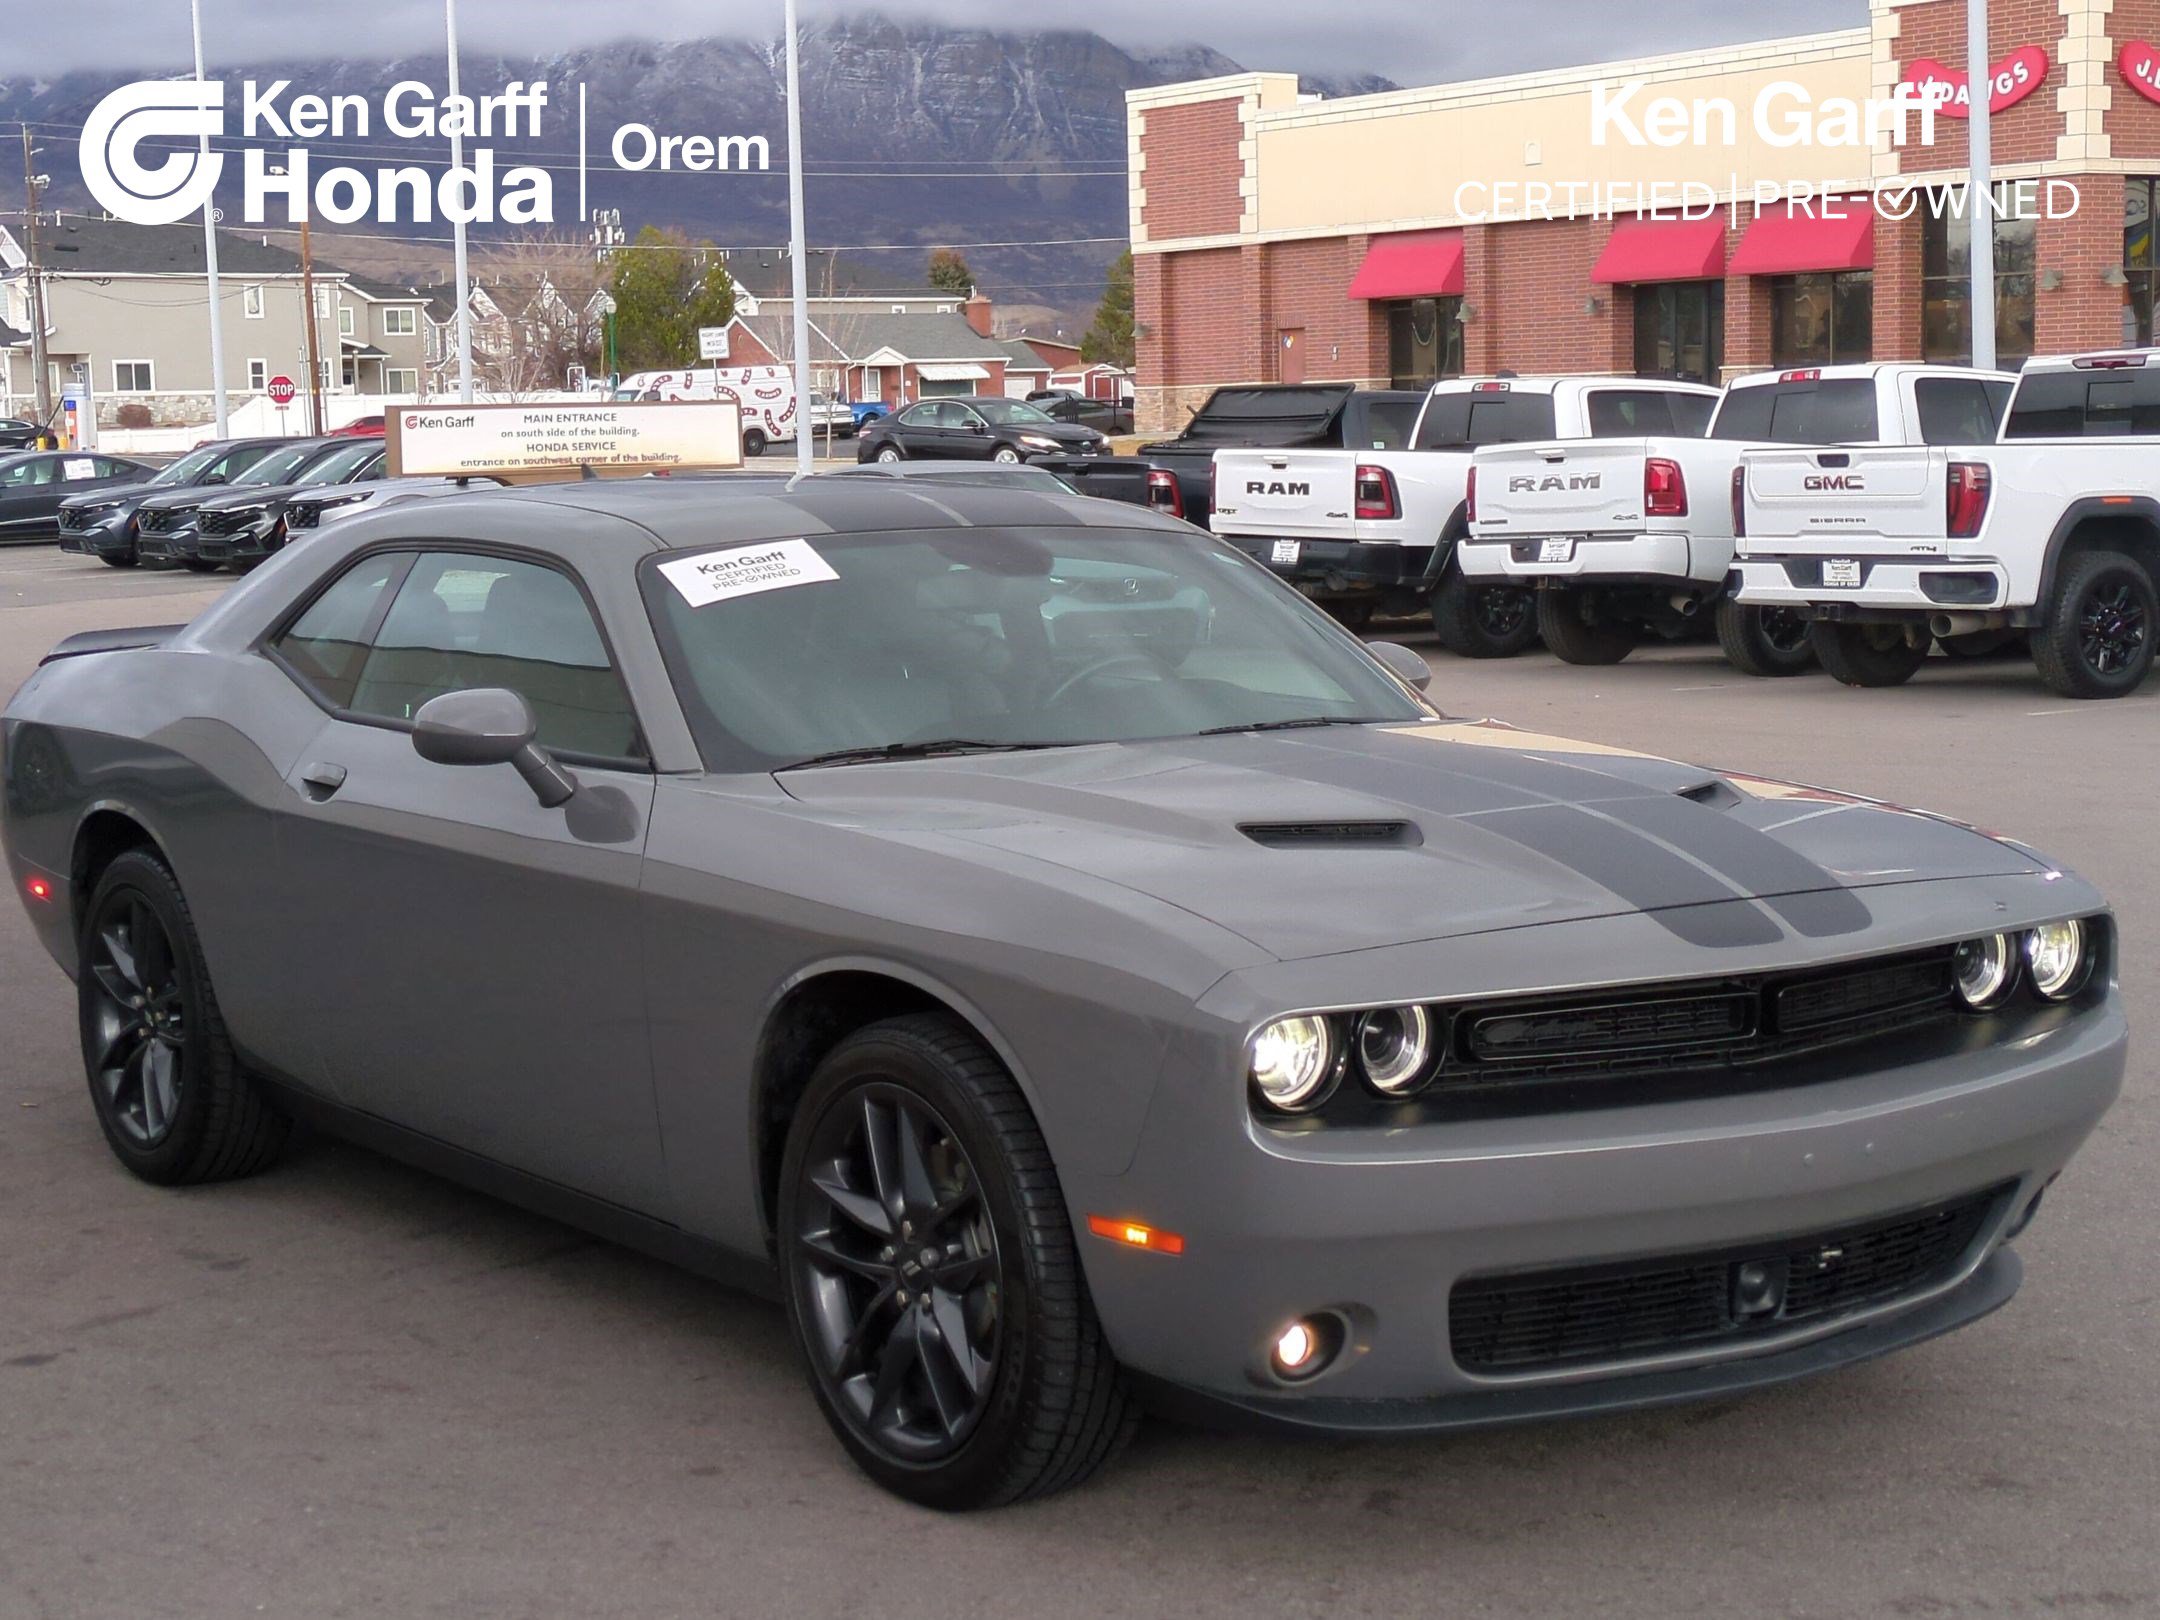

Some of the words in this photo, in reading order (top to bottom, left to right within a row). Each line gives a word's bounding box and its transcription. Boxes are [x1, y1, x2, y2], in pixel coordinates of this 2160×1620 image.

[269, 384, 294, 396] STOP
[419, 416, 443, 428] Ken
[445, 415, 475, 428] Garff
[523, 414, 553, 423] MAIN
[556, 412, 617, 423] ENTRANCE
[500, 430, 514, 438] on
[516, 428, 544, 438] south
[546, 427, 566, 437] side
[568, 427, 579, 436] of
[581, 426, 597, 436] the
[599, 425, 640, 438] building.
[526, 442, 569, 452] HONDA
[572, 441, 617, 451] SERVICE
[460, 458, 505, 467] entrance
[507, 457, 521, 465] on
[523, 455, 574, 465] southwest
[575, 455, 608, 464] corner
[610, 453, 622, 463] of
[622, 453, 639, 462] the
[641, 451, 682, 464] building.
[1246, 481, 1310, 495] RAM
[1509, 471, 1601, 493] RAM
[1804, 475, 1865, 491] GMC
[696, 561, 738, 575] Ken
[738, 551, 786, 566] Garff
[715, 563, 786, 581] CERTIFIED
